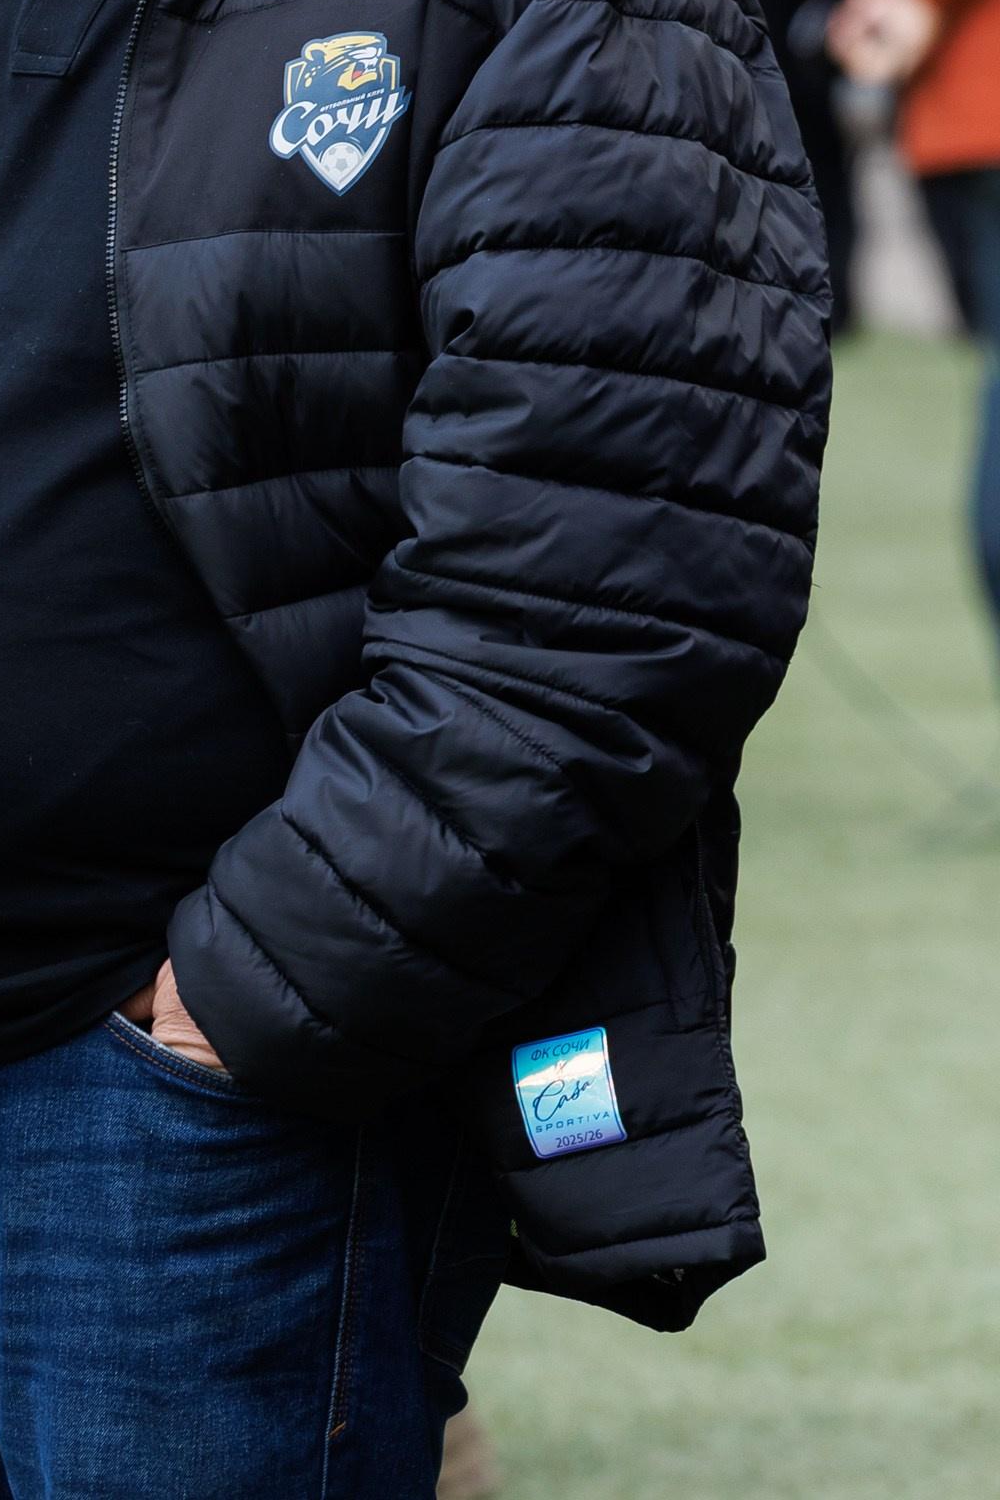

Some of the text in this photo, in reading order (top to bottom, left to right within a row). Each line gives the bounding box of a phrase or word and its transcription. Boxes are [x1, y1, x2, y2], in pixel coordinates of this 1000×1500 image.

[531, 1038, 590, 1061] ФК СОЧИ
[532, 1077, 596, 1122] Casa
[535, 1111, 611, 1133] SPORTIVA
[555, 1128, 603, 1148] 2025/26
